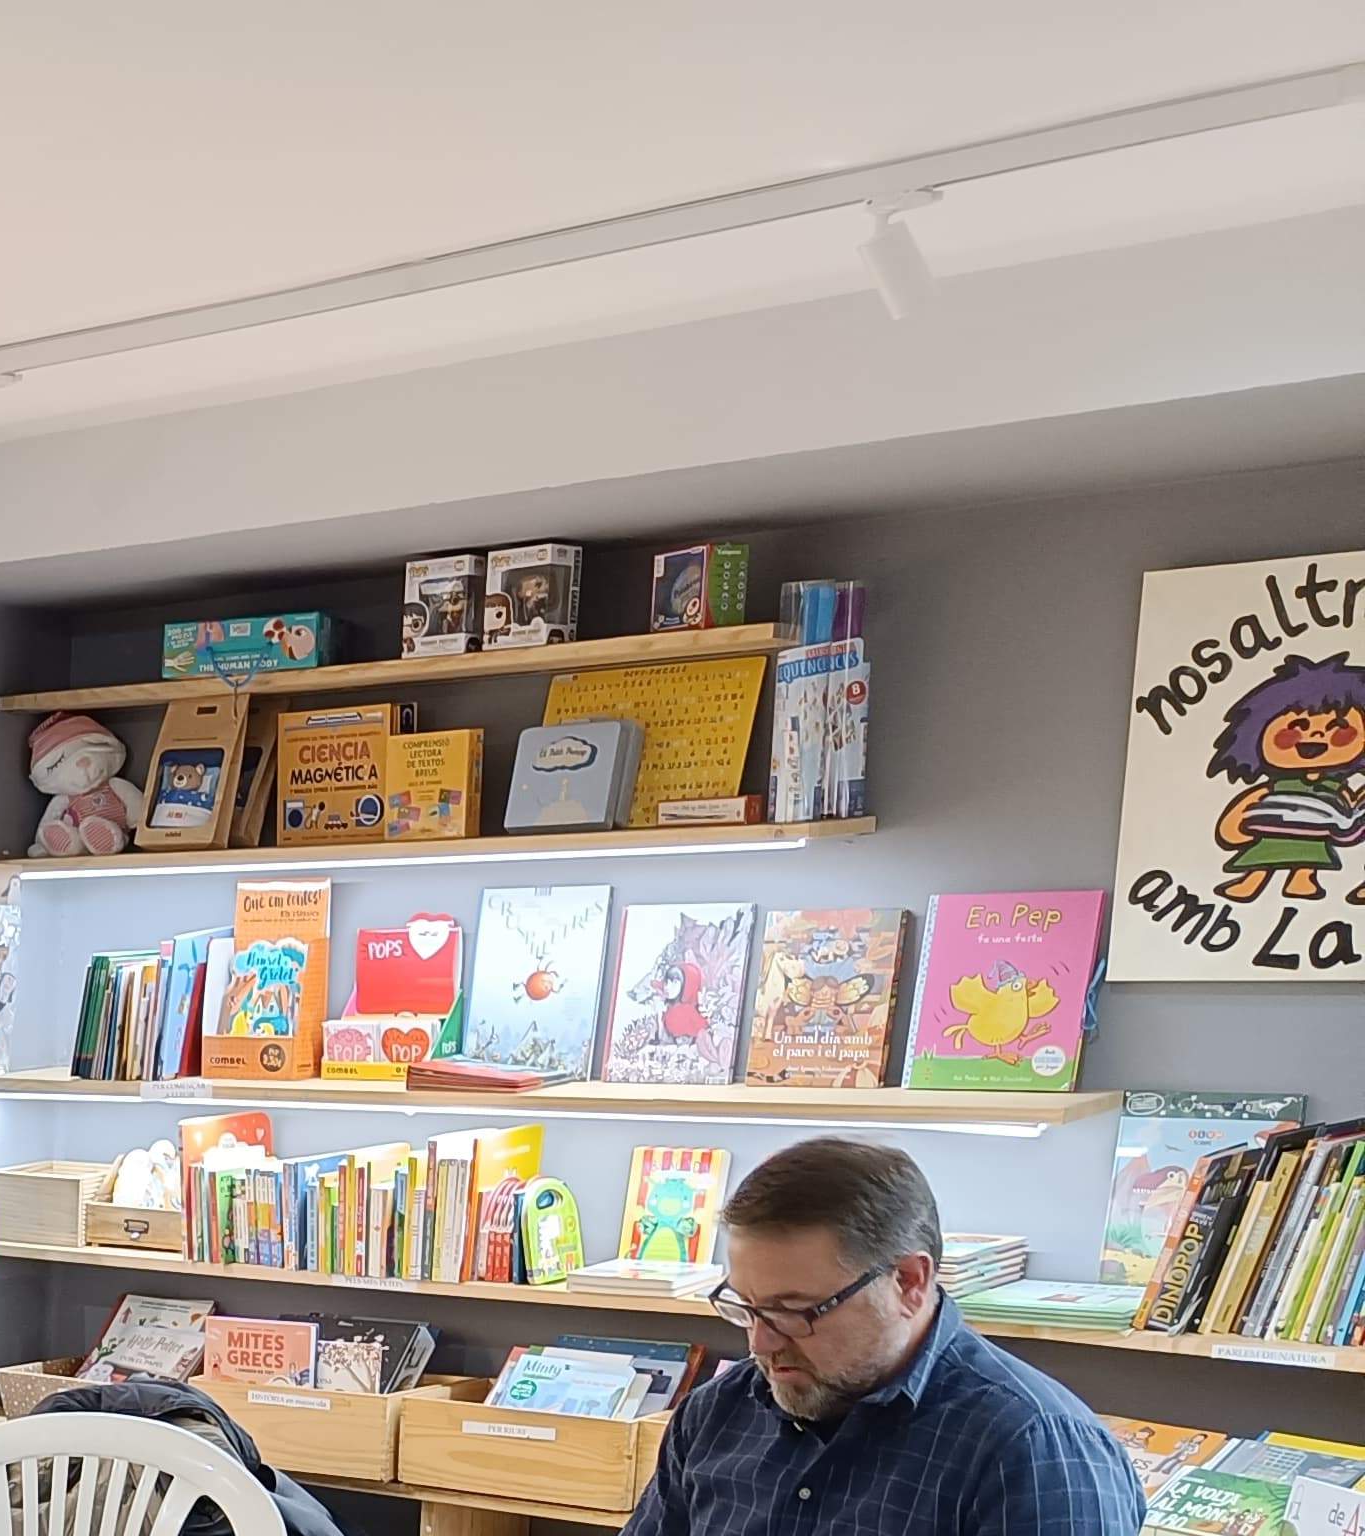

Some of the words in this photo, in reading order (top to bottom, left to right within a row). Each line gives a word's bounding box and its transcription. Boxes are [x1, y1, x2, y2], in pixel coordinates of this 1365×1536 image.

[299, 741, 371, 765] CIENCIA
[966, 905, 1002, 929] En
[1012, 903, 1062, 932] Pep
[1127, 868, 1241, 953] amb
[1252, 907, 1362, 970] La
[368, 940, 403, 960] POPS
[774, 1031, 791, 1043] Un
[796, 1030, 818, 1044] mal
[844, 1031, 872, 1045] amb
[334, 1045, 362, 1061] POP
[392, 1045, 420, 1061] POP
[773, 1044, 784, 1056] el
[825, 1045, 836, 1056] el
[1152, 1223, 1204, 1323] DINOPOP
[227, 1331, 284, 1350] MITES
[227, 1350, 284, 1369] GRECS
[1217, 1347, 1260, 1359] PARLEM
[1276, 1352, 1327, 1364] NATURA
[524, 1359, 562, 1377] Minty
[1193, 1484, 1241, 1506] VOLTA
[1328, 1503, 1345, 1527] de
